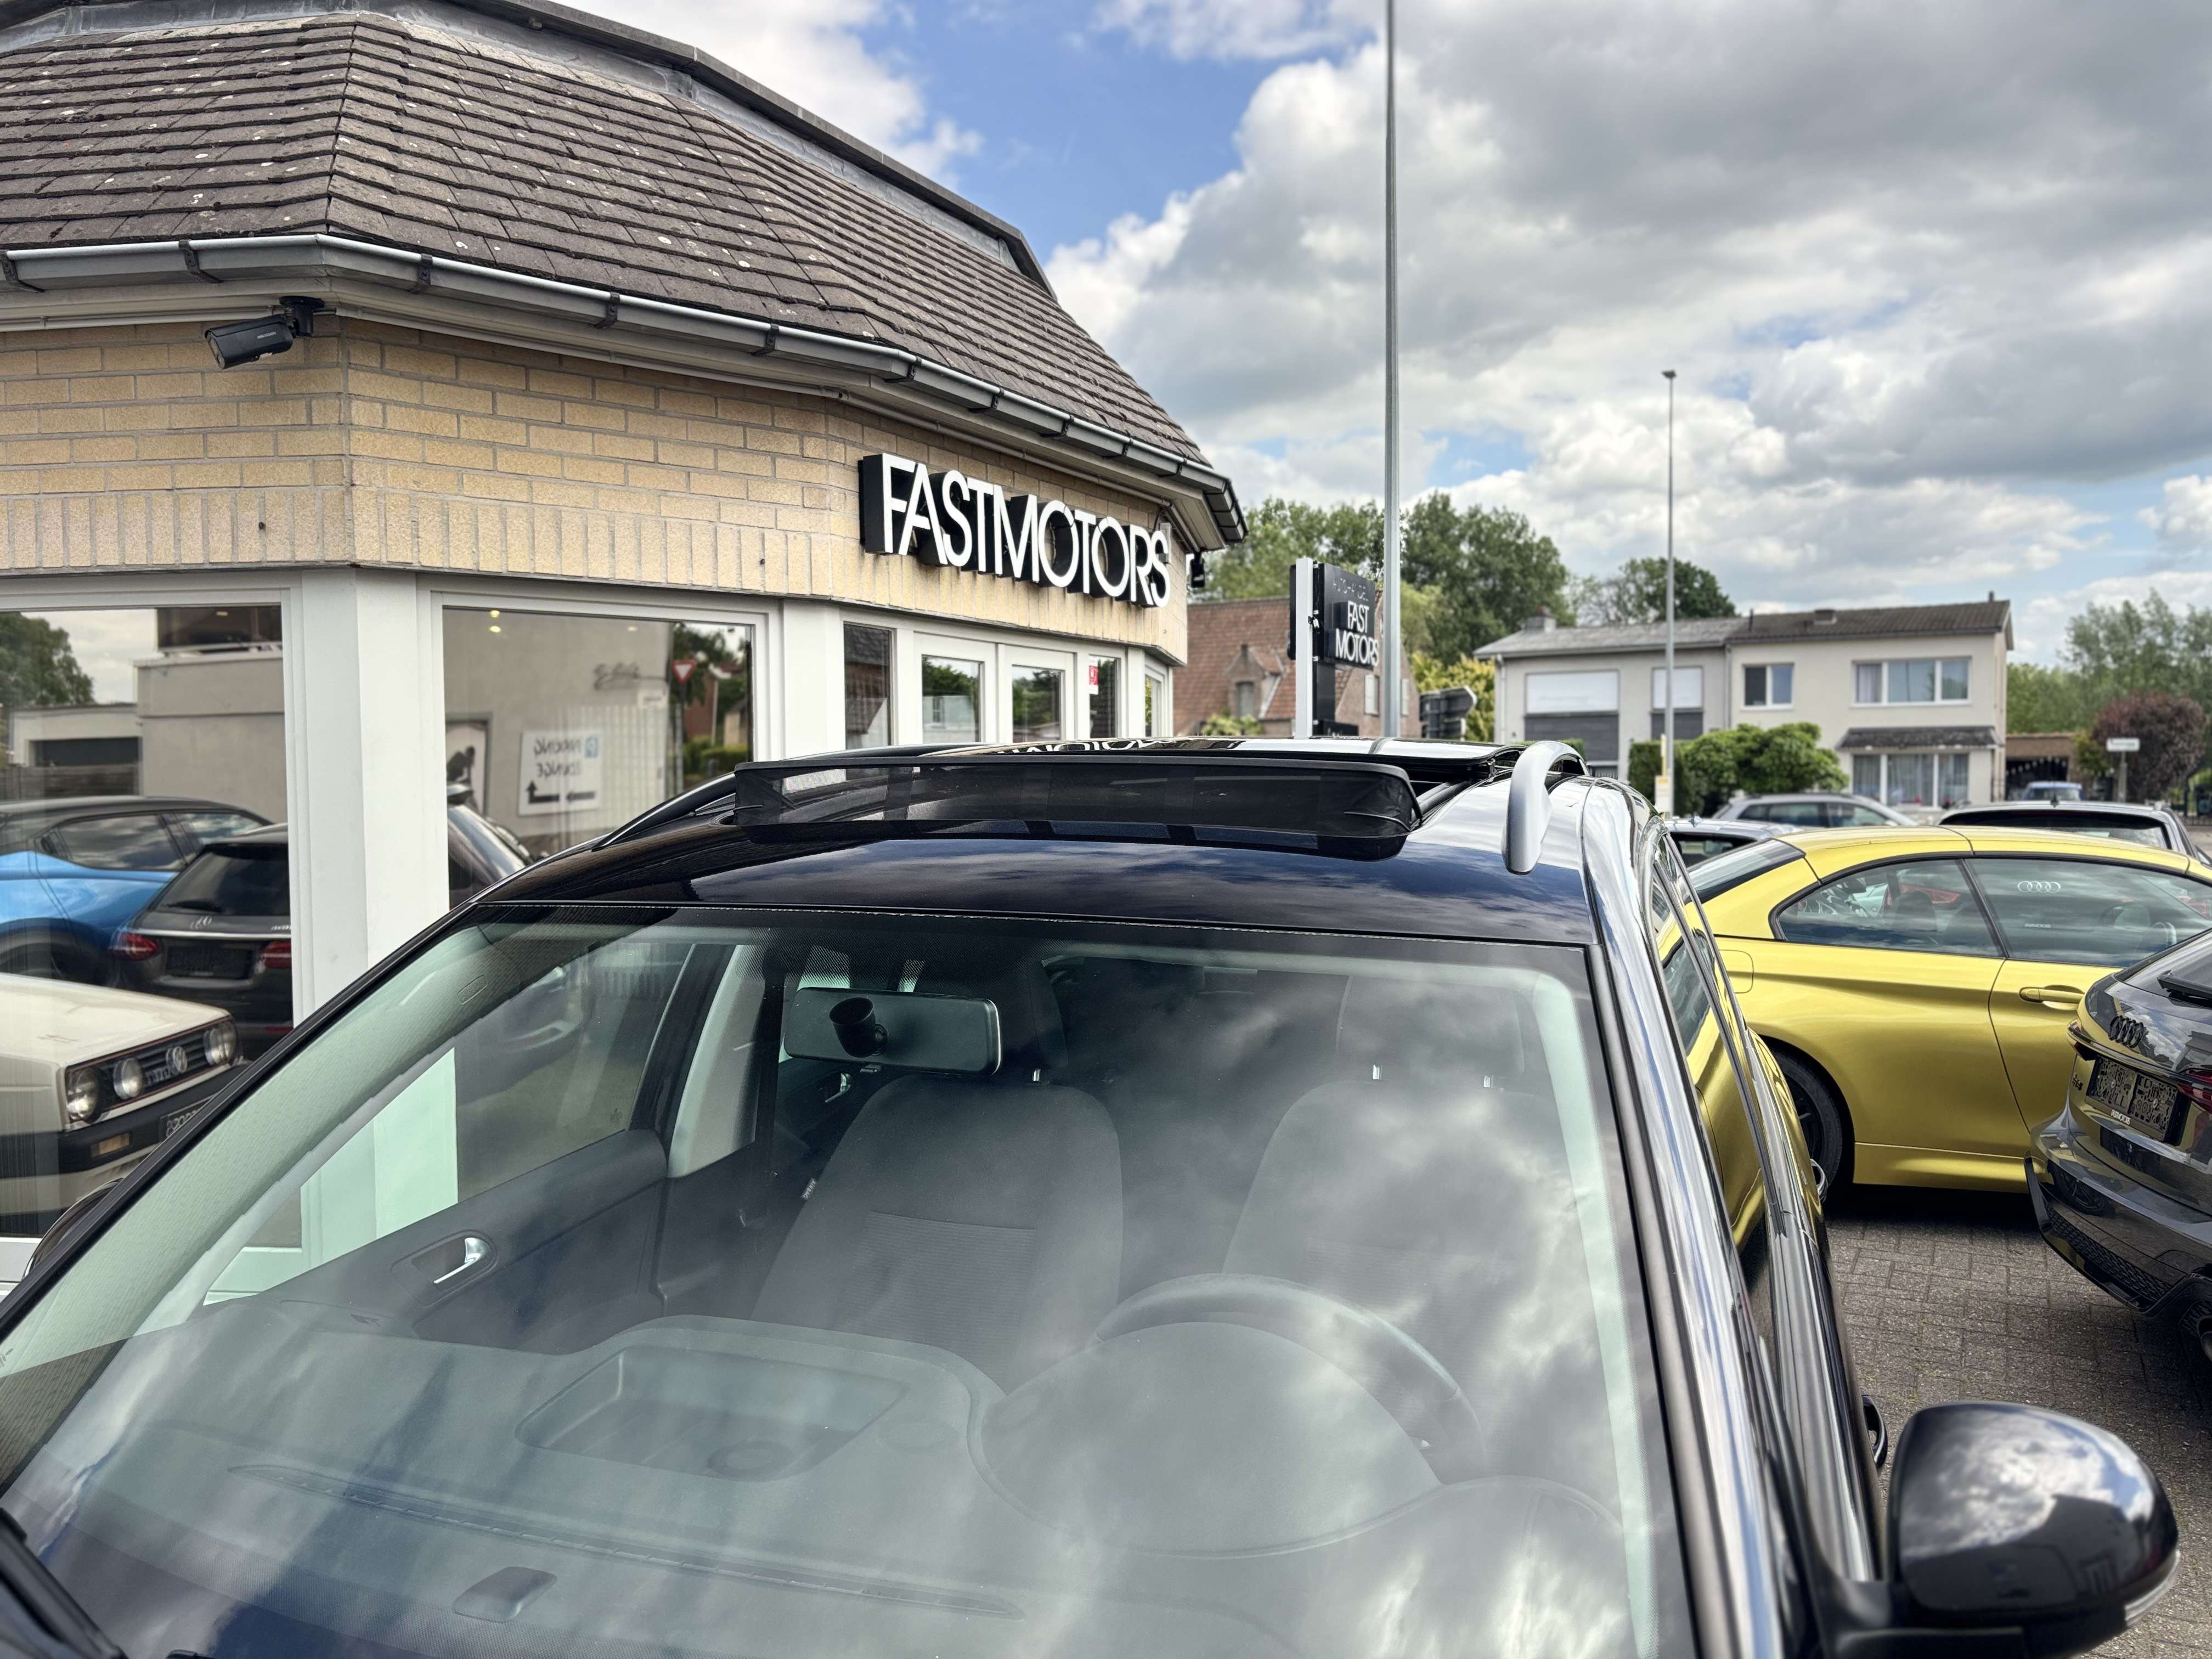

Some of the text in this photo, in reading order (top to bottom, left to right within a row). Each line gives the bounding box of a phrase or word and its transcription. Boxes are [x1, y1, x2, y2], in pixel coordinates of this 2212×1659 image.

[882, 453, 1171, 607] FASTMOTORS
[1347, 601, 1369, 633] FAST
[1335, 628, 1379, 666] MOTORS
